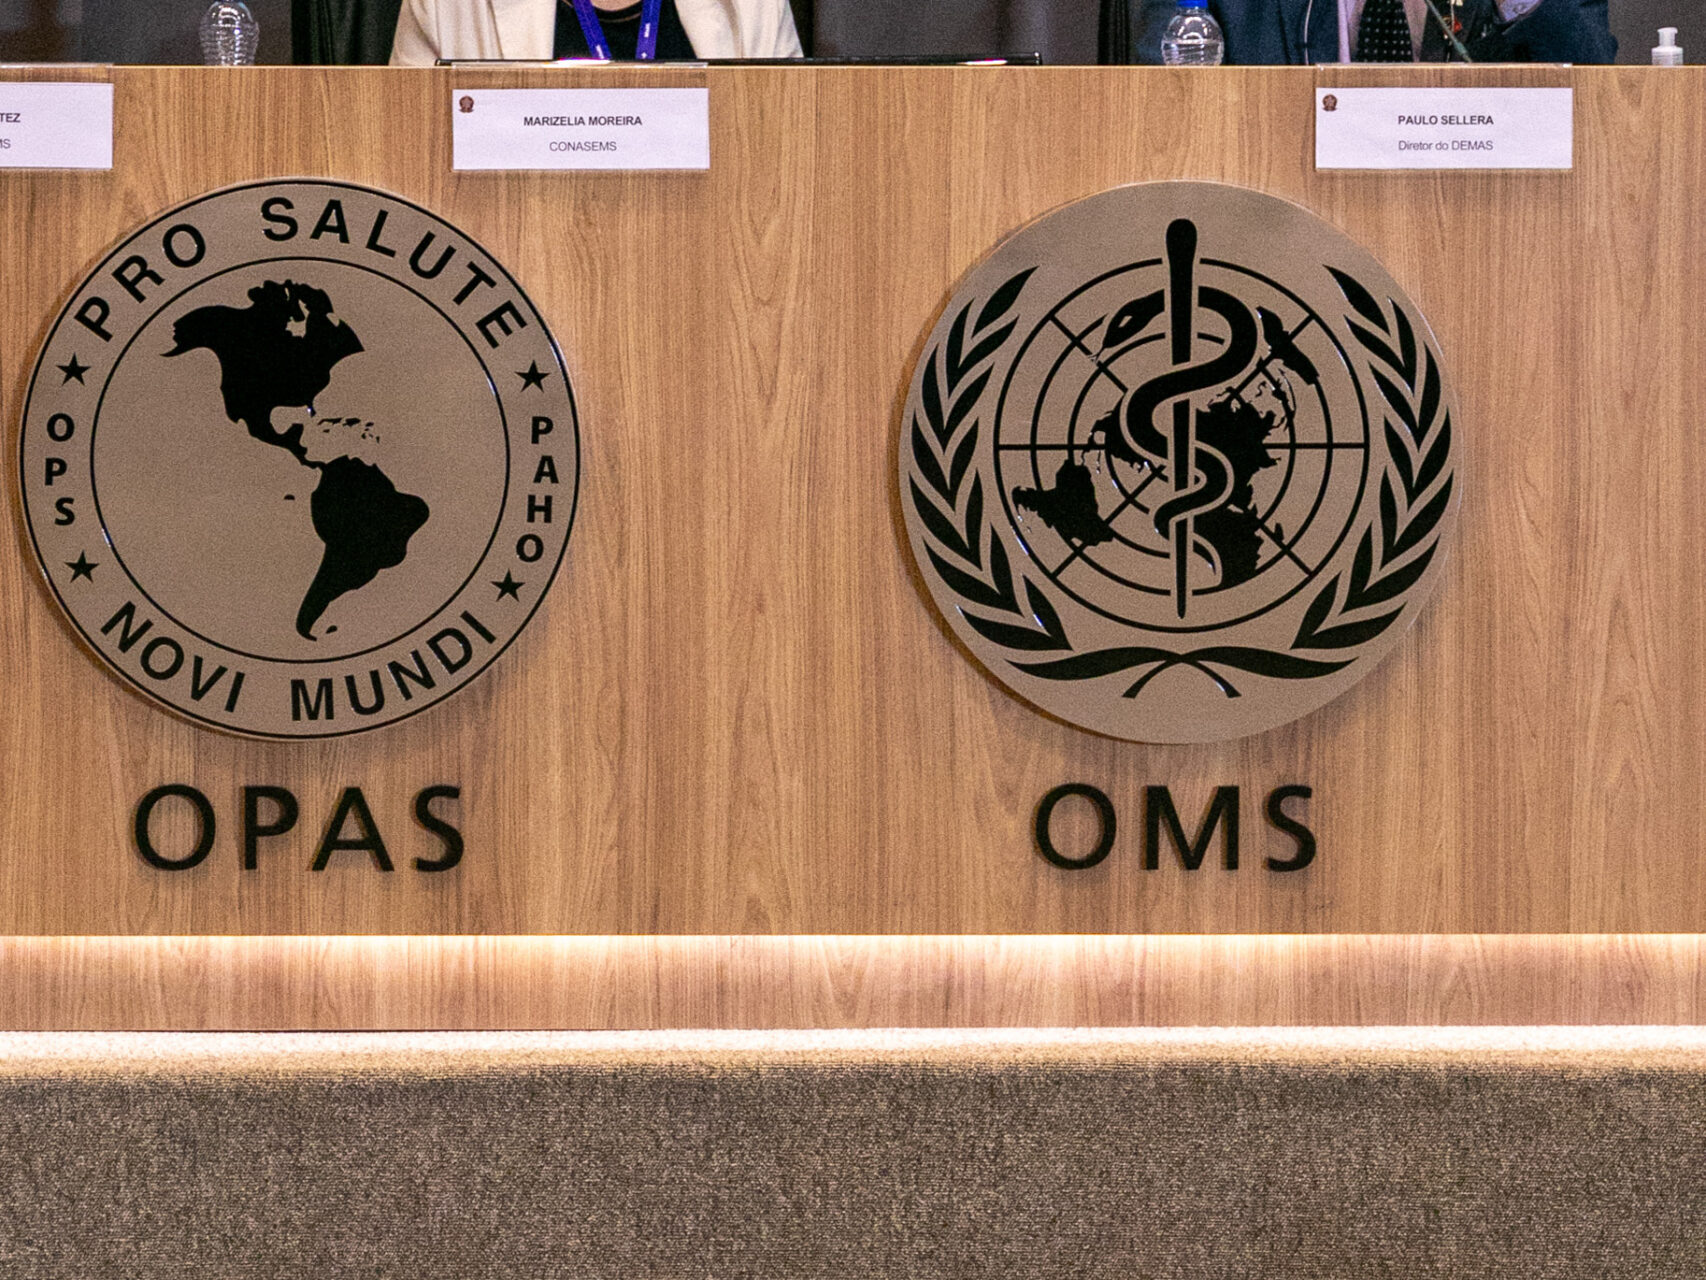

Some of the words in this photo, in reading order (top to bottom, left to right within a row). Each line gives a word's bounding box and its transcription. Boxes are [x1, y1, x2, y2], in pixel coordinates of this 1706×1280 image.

[523, 116, 586, 126] MARIZELIA
[588, 116, 643, 126] MOREIRA
[549, 141, 617, 152] CONASEMS
[1397, 115, 1438, 126] PAULO
[1440, 115, 1494, 126] SELLERA
[1398, 140, 1433, 151] Diretor
[1435, 140, 1449, 151] do
[1451, 140, 1494, 151] DEMAS
[74, 223, 206, 343] PRO
[260, 196, 528, 349] SALUTE
[44, 413, 76, 526] OPS
[515, 416, 560, 563] PAHO
[100, 600, 246, 713] NOVI
[290, 610, 497, 721] MUNDI
[132, 784, 465, 872] OPAS
[1033, 783, 1317, 872] OMS
